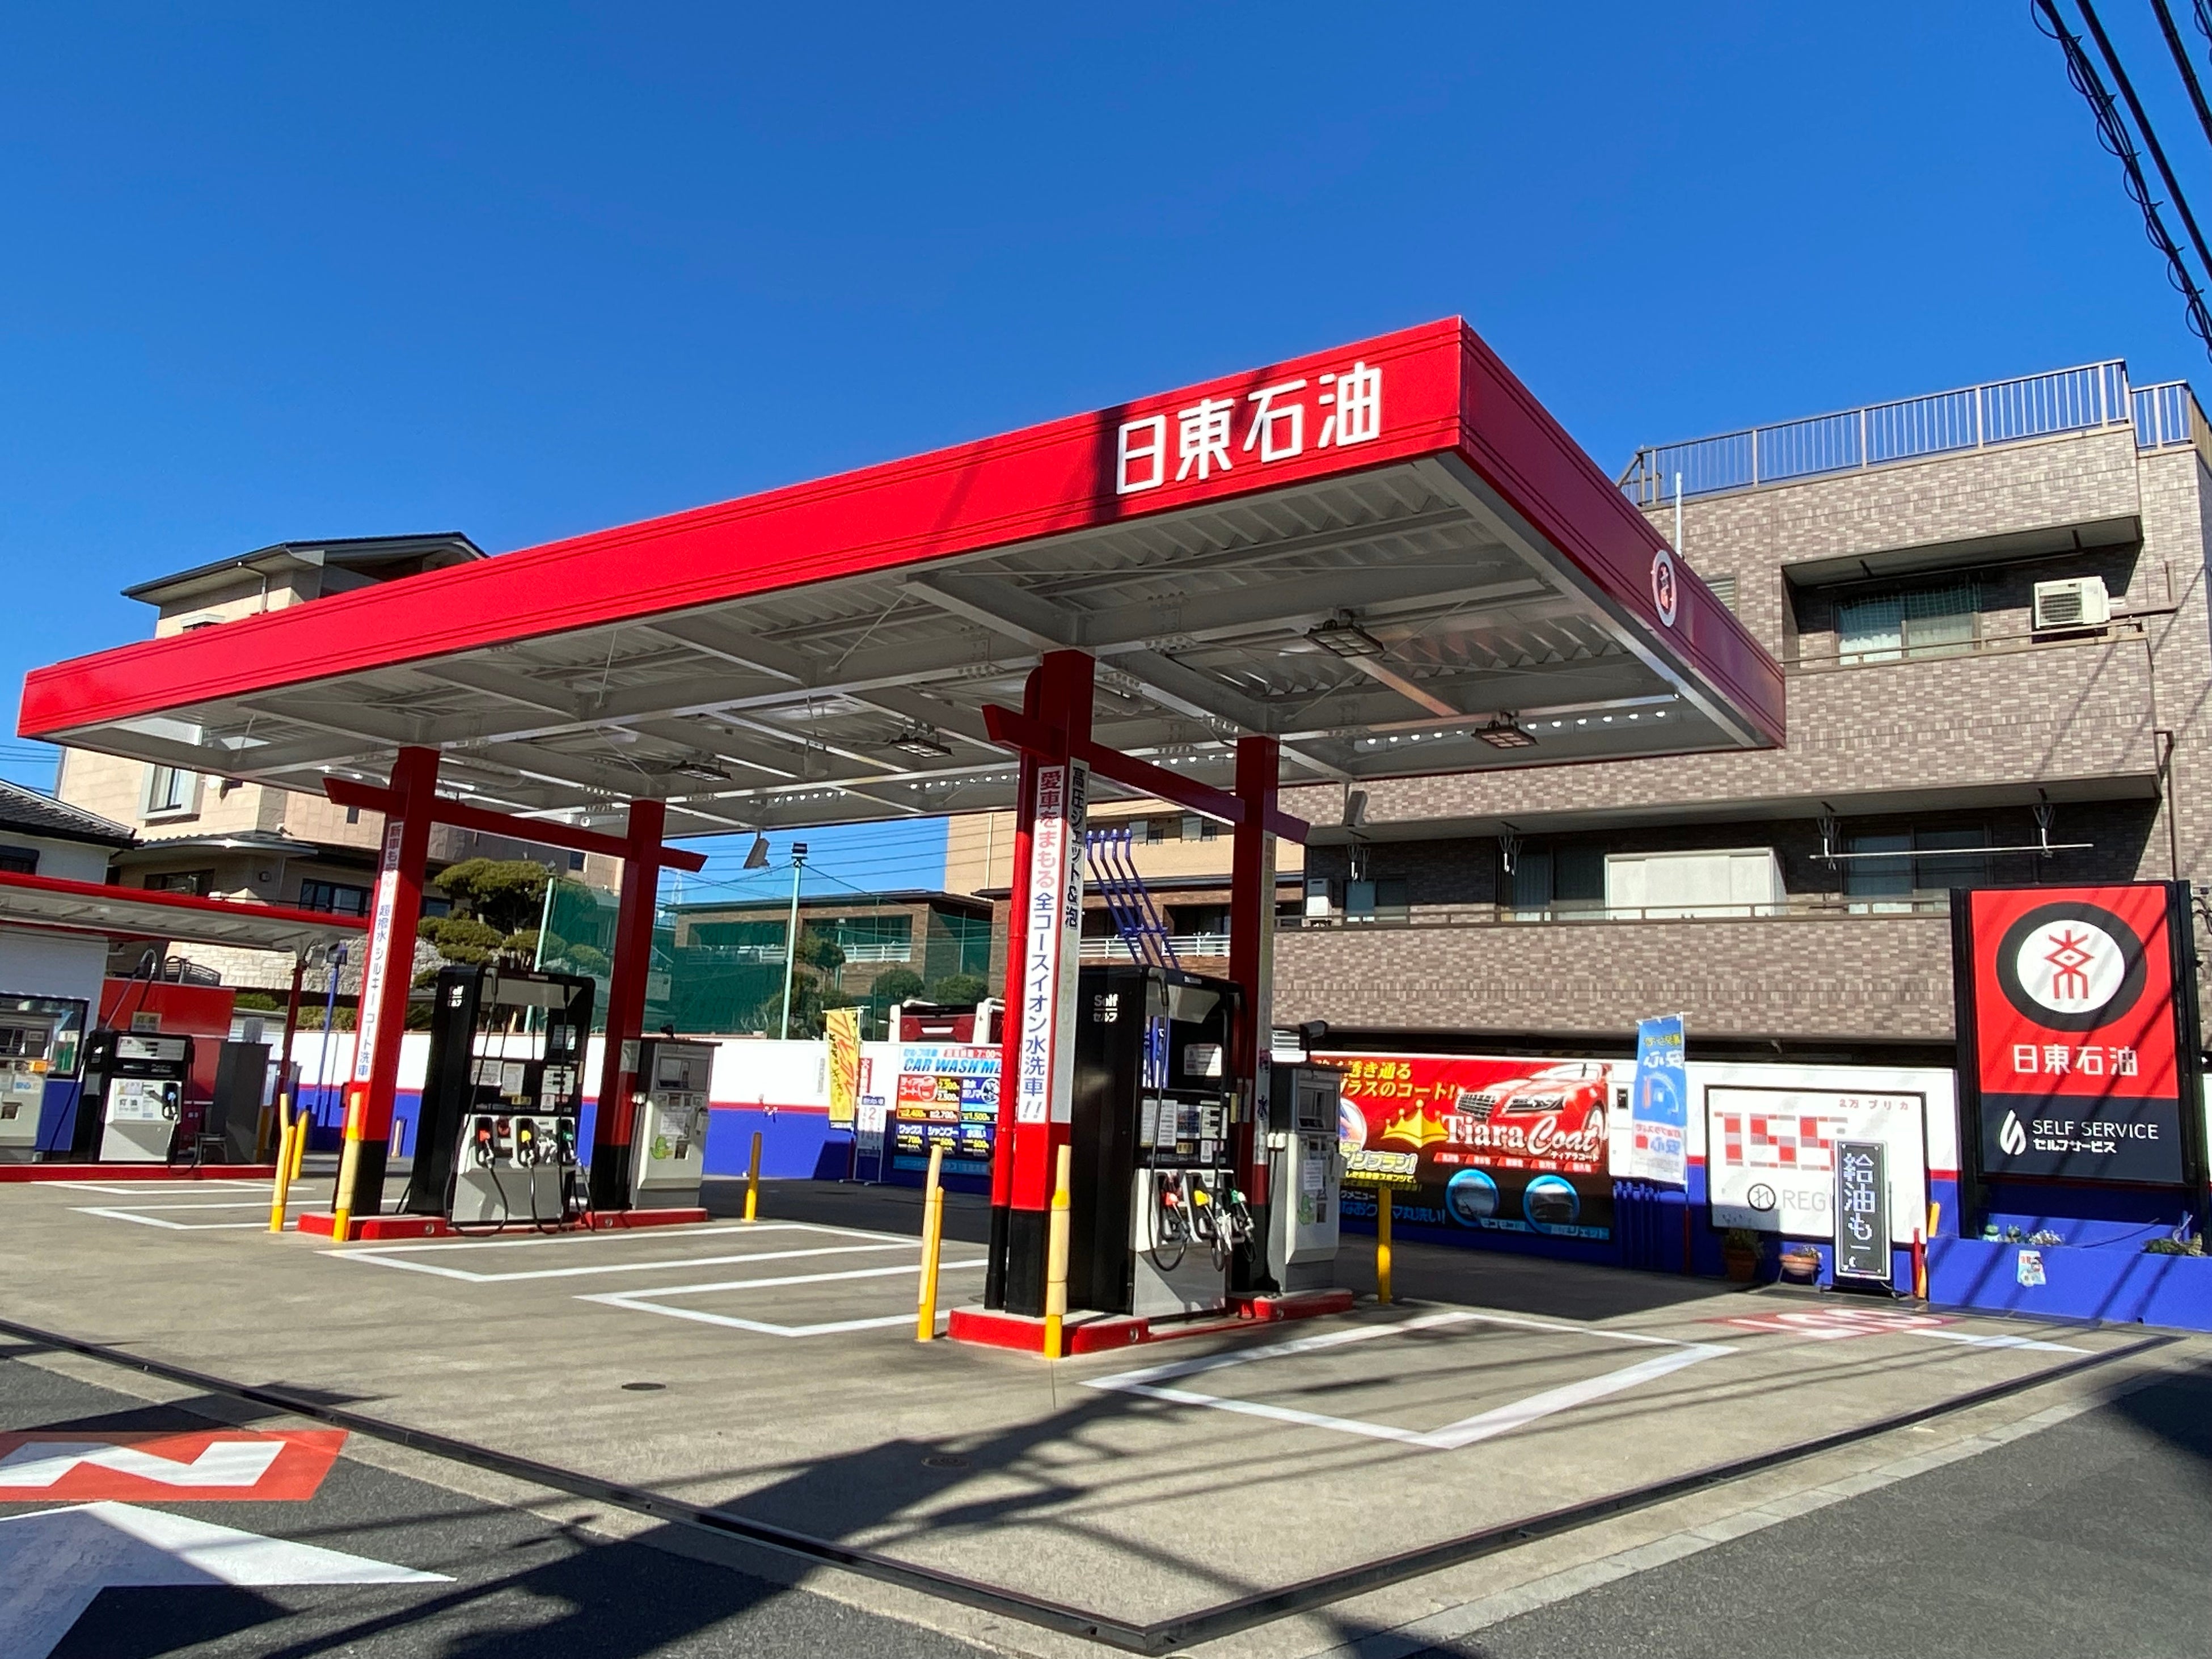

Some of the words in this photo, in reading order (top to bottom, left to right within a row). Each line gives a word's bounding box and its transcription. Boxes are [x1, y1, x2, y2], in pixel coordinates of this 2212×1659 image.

[1116, 361, 1382, 495] 日東石油
[1094, 994, 1118, 1007] Self
[1093, 1012, 1118, 1023] セルフ
[904, 1058, 932, 1071] CAR
[935, 1059, 979, 1073] WASH
[2013, 1044, 2138, 1077] 日東石油
[1441, 1115, 1525, 1149] Tiara
[1526, 1116, 1599, 1155] Coat
[2032, 1120, 2075, 1135] SELF
[2081, 1121, 2159, 1139] SERVICE
[2033, 1138, 2117, 1154] セルフサービス
